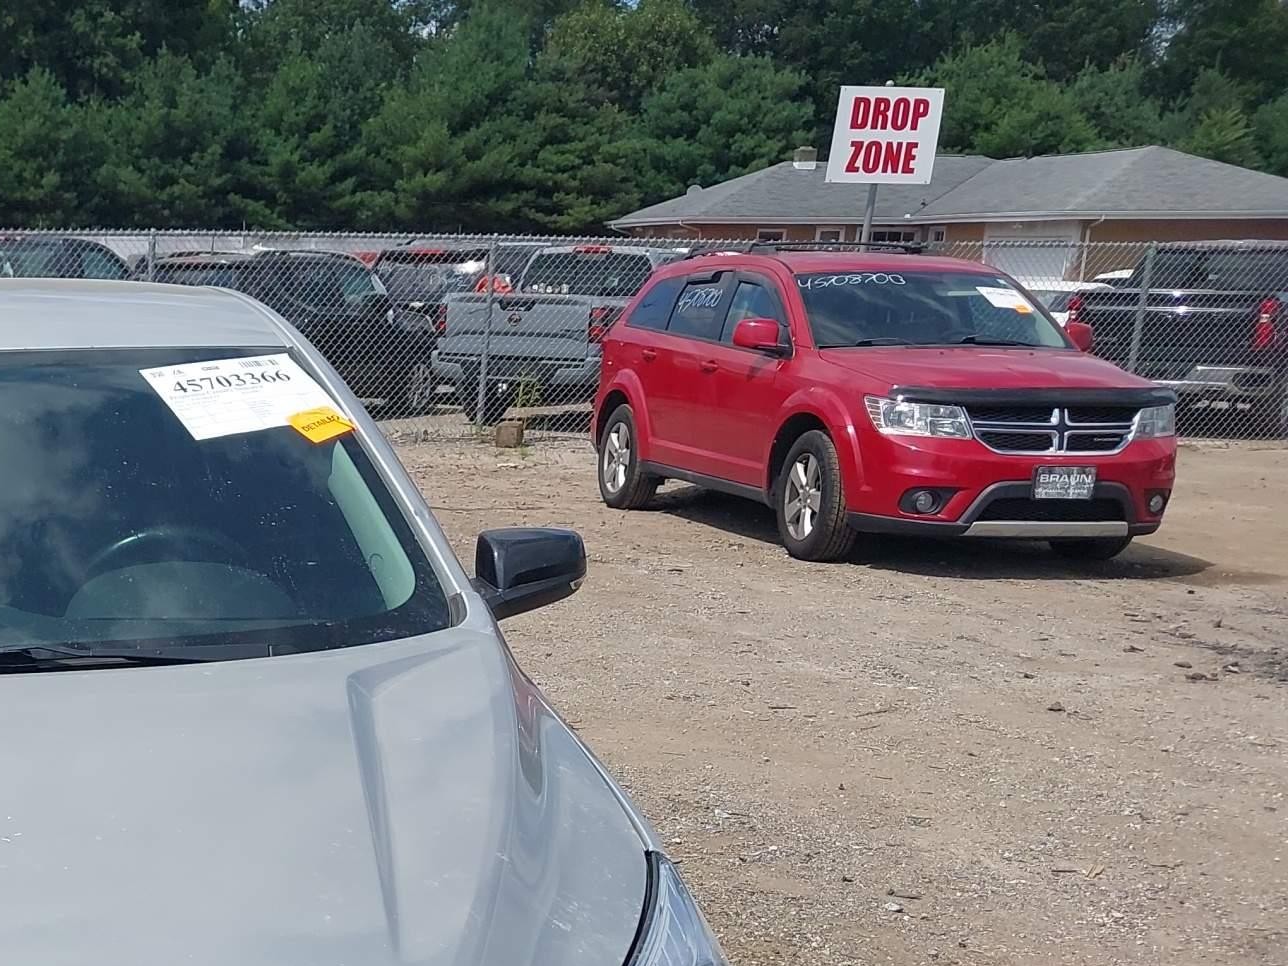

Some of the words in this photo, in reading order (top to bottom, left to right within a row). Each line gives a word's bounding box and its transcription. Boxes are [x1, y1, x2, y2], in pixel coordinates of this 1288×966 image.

[849, 96, 930, 131] DROP
[844, 140, 919, 174] ZONE
[173, 369, 291, 393] 45703366
[1039, 473, 1092, 484] BRAUN
